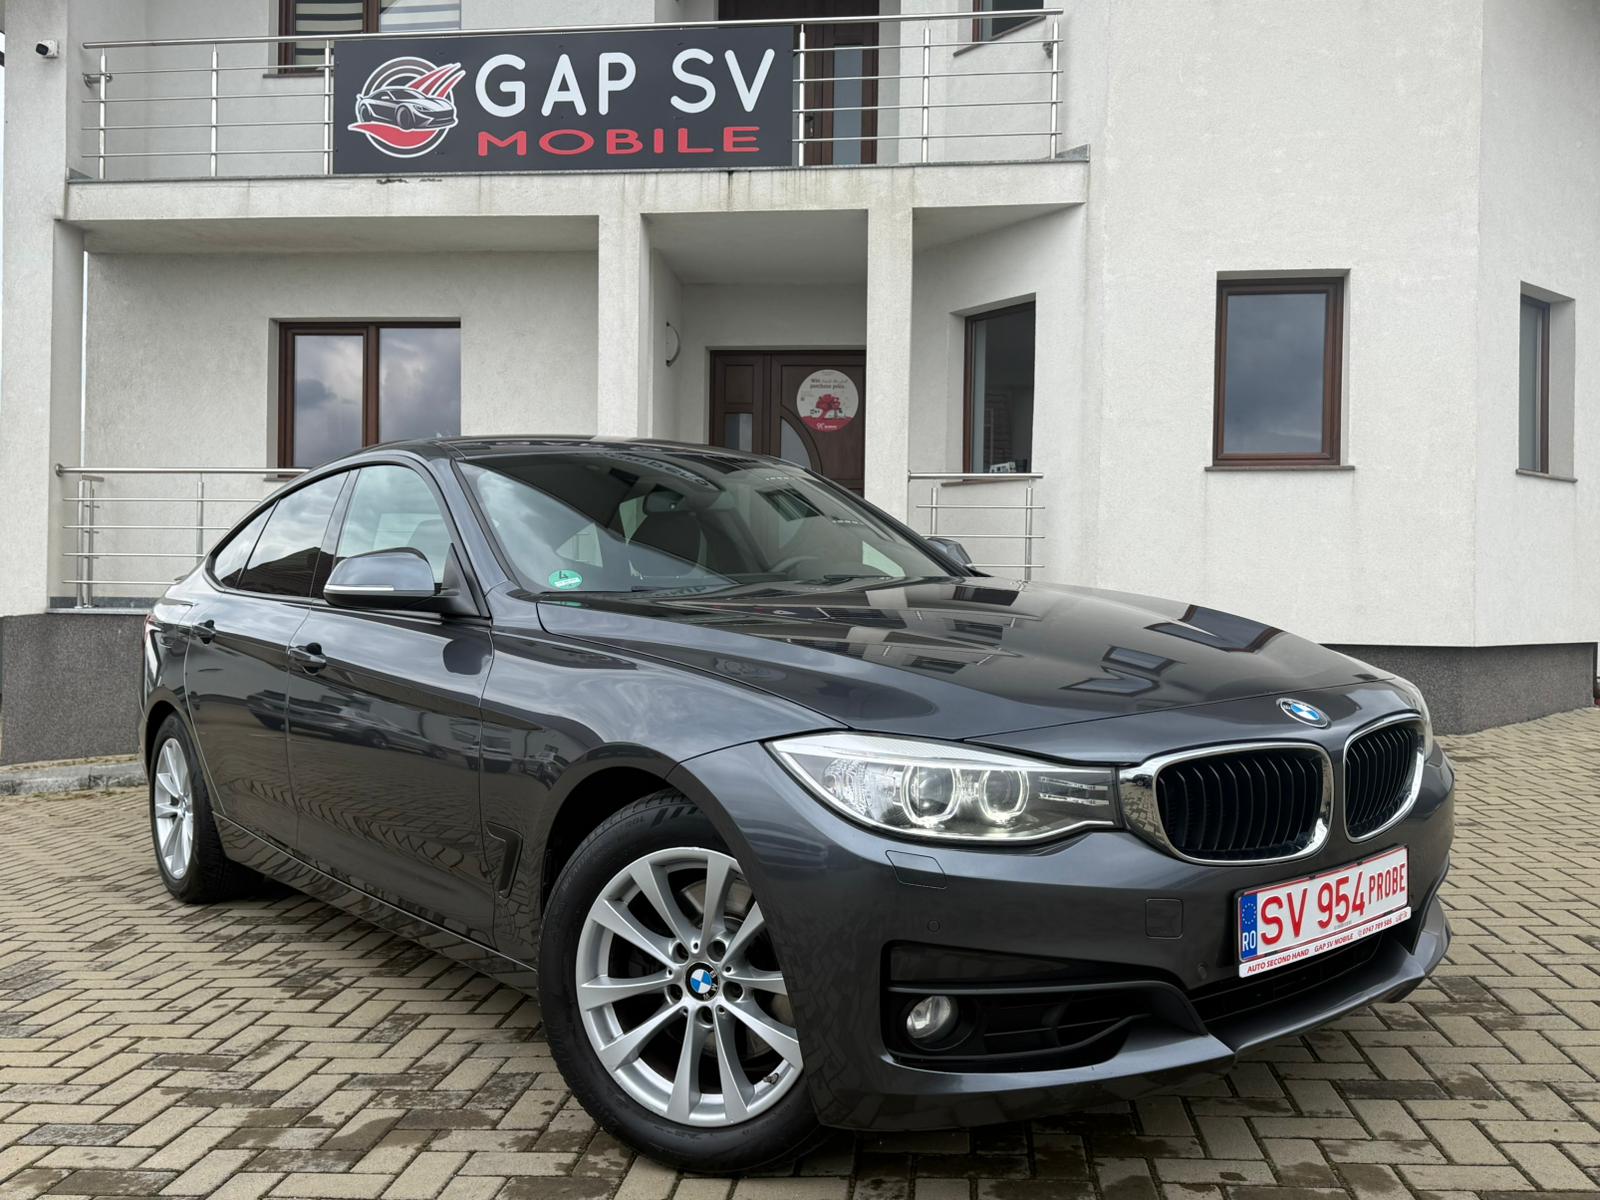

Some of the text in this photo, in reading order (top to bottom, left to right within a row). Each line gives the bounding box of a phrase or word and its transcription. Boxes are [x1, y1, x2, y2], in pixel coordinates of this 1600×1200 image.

[475, 48, 775, 118] GAP SV
[477, 126, 761, 157] MOBILE
[1260, 863, 1406, 945] SV 954 PROBE
[1242, 929, 1256, 952] RO
[1247, 962, 1266, 974] AUTO
[1266, 954, 1291, 968] SECOND
[1291, 949, 1310, 961] HAND
[1314, 943, 1326, 953] GAP
[1326, 940, 1335, 949] SV
[1333, 933, 1354, 946] MOBILE
